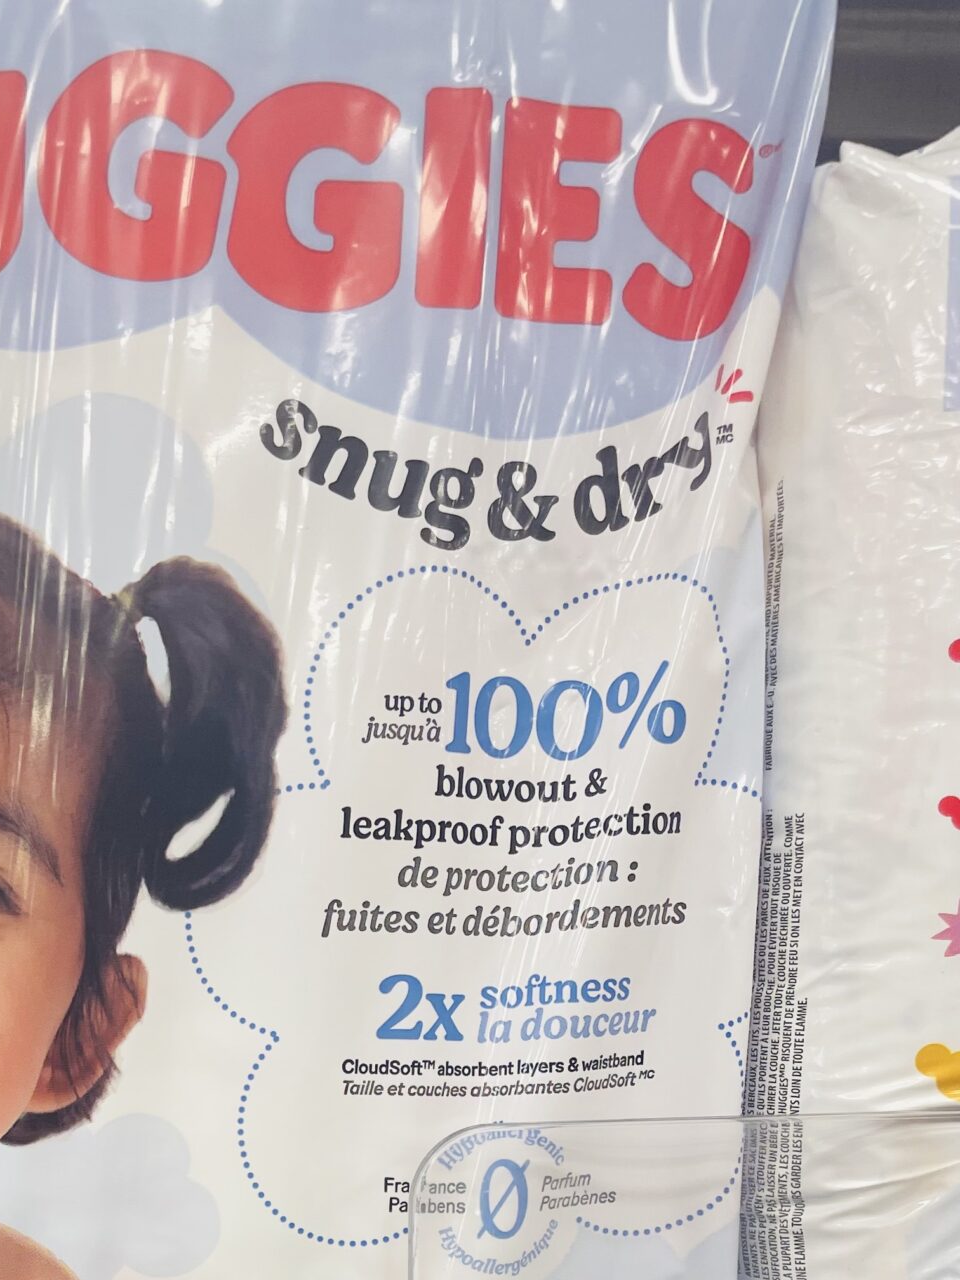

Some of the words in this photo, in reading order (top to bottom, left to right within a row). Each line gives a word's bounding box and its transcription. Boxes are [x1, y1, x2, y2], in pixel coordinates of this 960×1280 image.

[717, 423, 733, 434] TM
[259, 399, 484, 551] snug
[487, 460, 559, 542] &
[573, 410, 712, 535] dry
[384, 694, 415, 716] up
[418, 692, 442, 714] to
[445, 660, 687, 761] 100%
[435, 764, 577, 803] blowout
[584, 768, 607, 795] &
[340, 807, 504, 849] leakproof
[508, 804, 682, 854] protection
[784, 815, 793, 847] COMME
[795, 813, 805, 834] AVEC
[793, 836, 804, 874] CONTACT
[398, 857, 439, 888] de
[443, 858, 619, 896] protection
[771, 865, 781, 896] RISQUE
[321, 899, 420, 938] fuites
[427, 909, 456, 936] et
[463, 898, 687, 937] débordements
[777, 907, 789, 947] DÉCHIRÉE
[767, 952, 775, 974] POUR
[754, 960, 765, 1009] POUSSETTES
[785, 967, 798, 1006] PRENDRE
[376, 974, 465, 1042] 2x
[479, 974, 631, 1009] softness
[477, 1010, 511, 1044] la
[520, 1006, 656, 1042] douceur
[761, 1015, 770, 1036] LEUR
[794, 997, 808, 1036] FLAMME.
[769, 1037, 780, 1071] COUCHE.
[780, 1020, 793, 1061] RISQUENT
[792, 1038, 804, 1064] TOUTE
[437, 1060, 513, 1076] absorbent
[517, 1059, 564, 1077] layers
[568, 1058, 579, 1071] &
[582, 1051, 644, 1070] waistband
[759, 1045, 768, 1082] PORTENT
[342, 1080, 384, 1095] Taille
[387, 1082, 404, 1095] et
[407, 1081, 467, 1096] couches
[470, 1079, 570, 1097] absorbantes
[790, 1080, 801, 1098] LOIN
[542, 1172, 591, 1192] Parfum
[765, 1164, 775, 1198] LAISSER
[791, 1155, 801, 1188] GARDER
[540, 1189, 616, 1211] Parabènes
[439, 1218, 558, 1276] Hypoallergénique
[759, 1230, 768, 1265] ENFANTS
[780, 1236, 792, 1271] PLUPART
